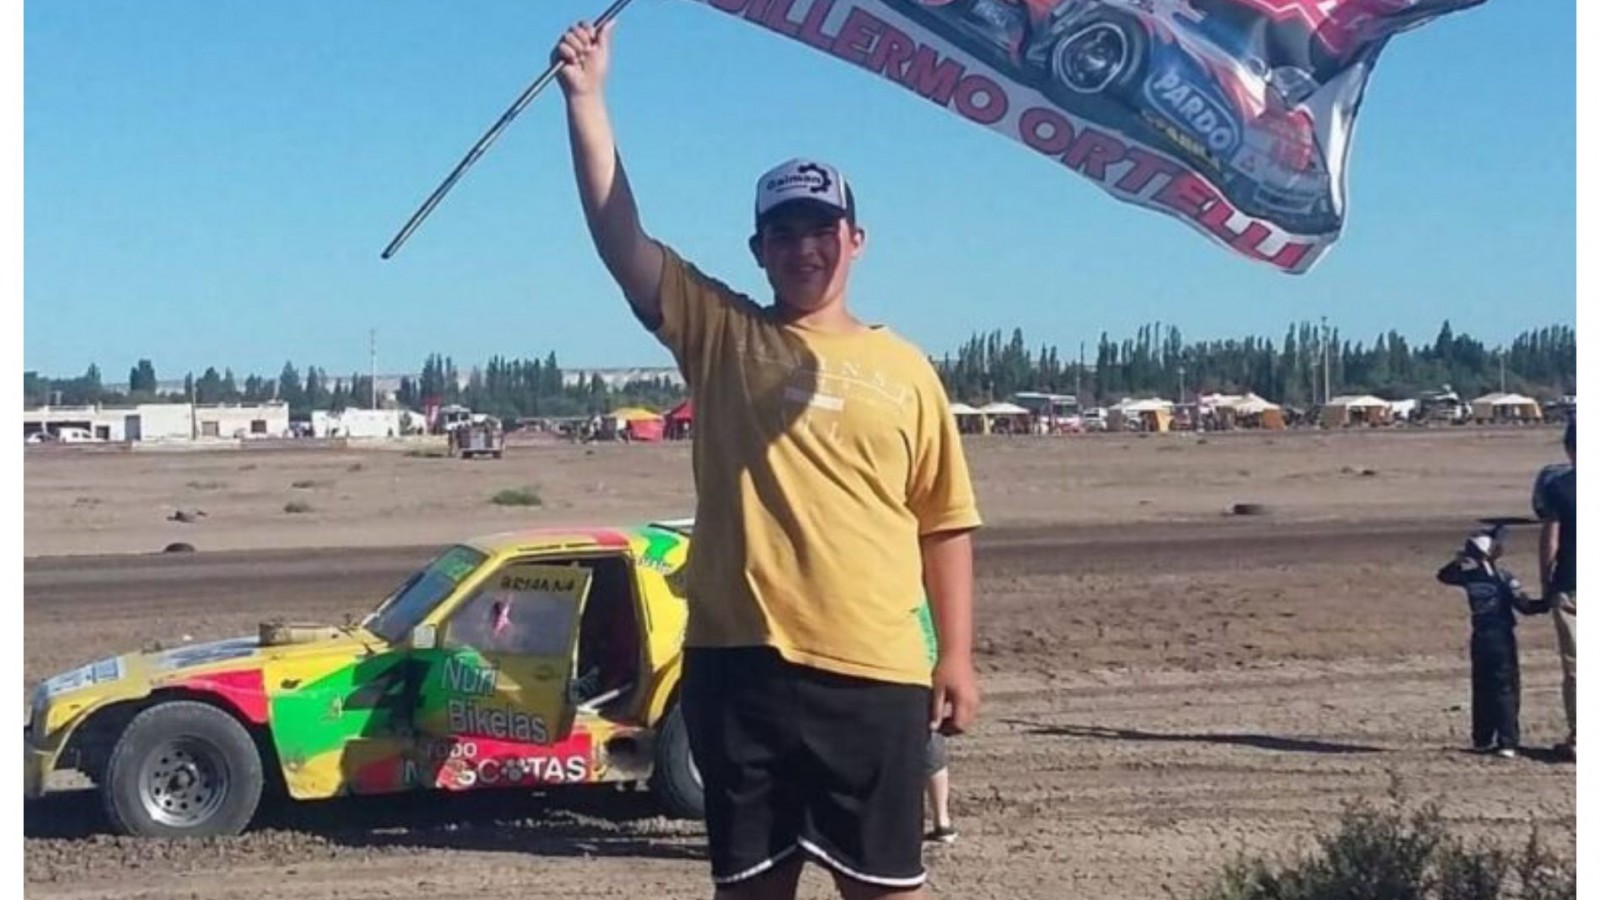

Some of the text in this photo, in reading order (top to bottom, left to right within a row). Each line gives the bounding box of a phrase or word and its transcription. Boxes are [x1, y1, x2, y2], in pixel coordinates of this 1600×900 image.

[1153, 71, 1233, 150] PARDO
[1018, 106, 1315, 270] ORTELLI
[441, 655, 497, 695] Nuri
[449, 699, 547, 742] Bikelas
[426, 742, 478, 759] TODO
[404, 755, 588, 788] MSCTAS
